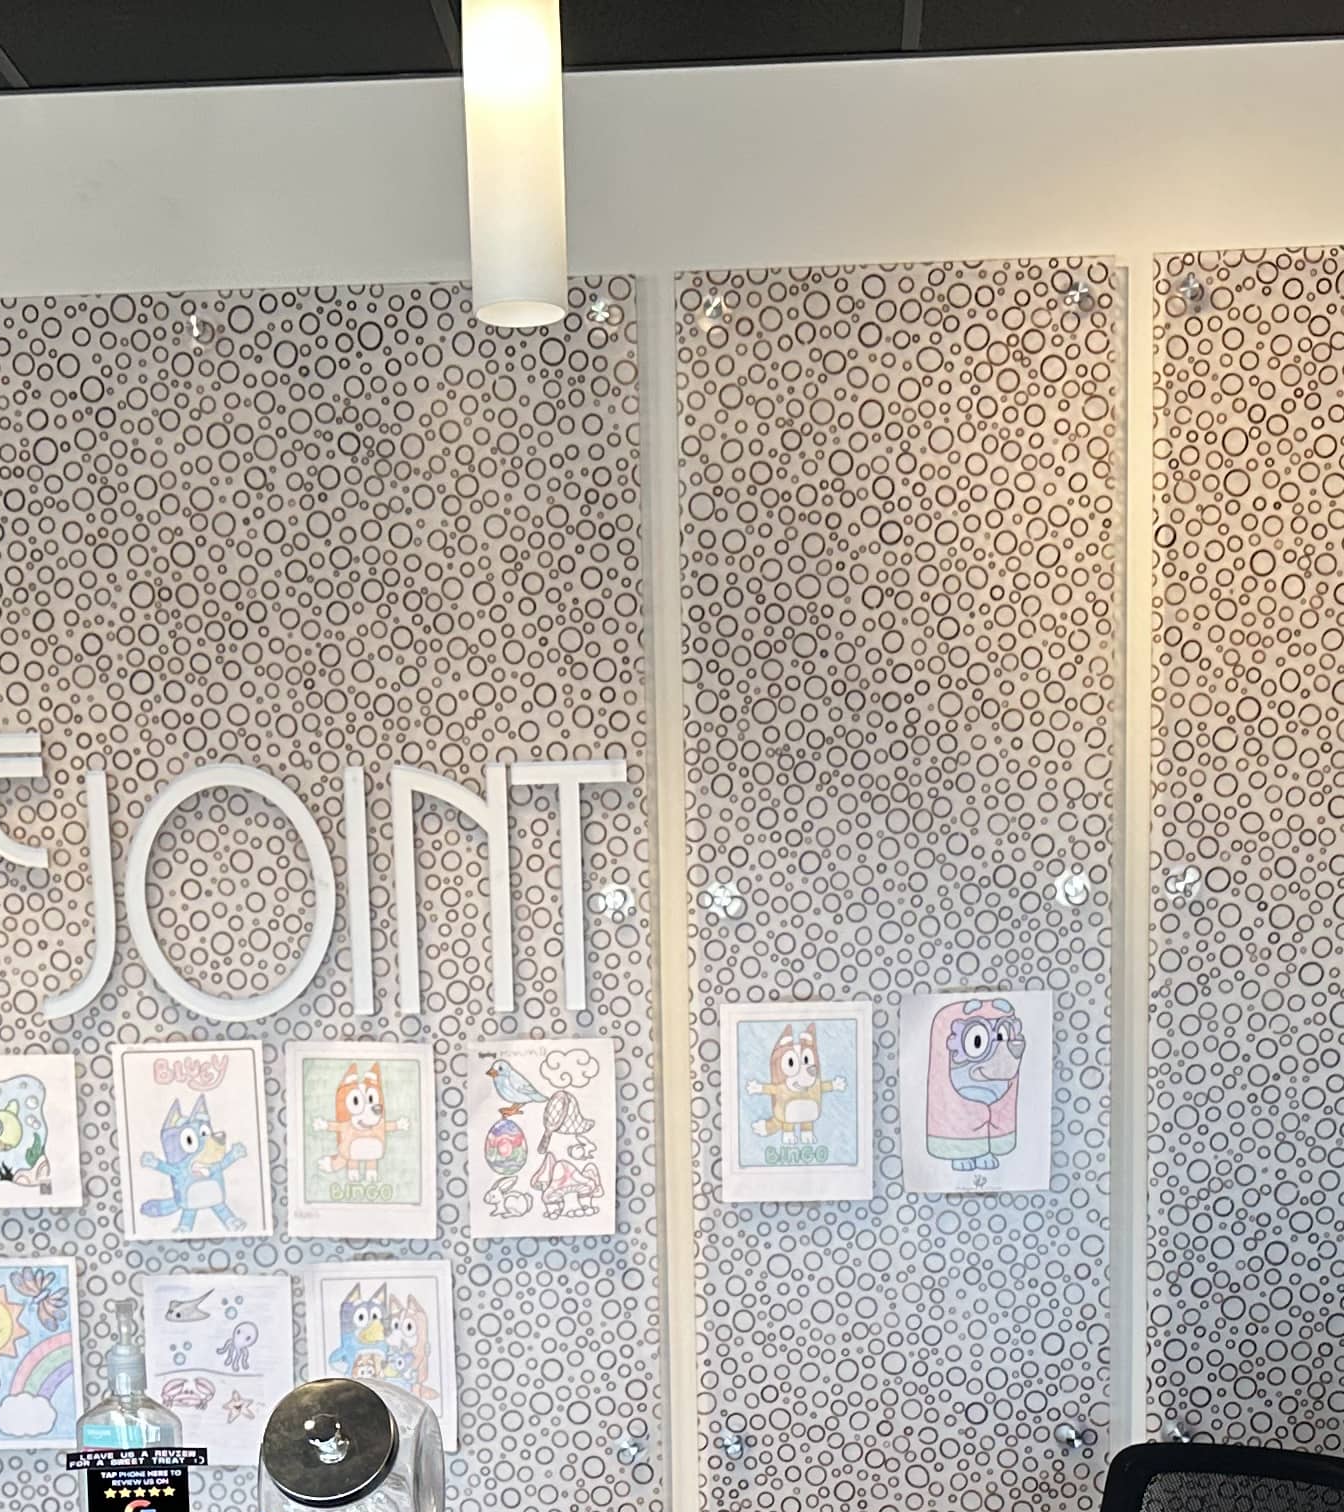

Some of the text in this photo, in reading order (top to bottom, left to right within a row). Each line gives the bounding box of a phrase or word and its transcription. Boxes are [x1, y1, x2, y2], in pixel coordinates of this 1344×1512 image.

[42, 758, 628, 1023] JOINT
[79, 1452, 114, 1461] LEAVE
[120, 1450, 135, 1459] US
[141, 1450, 149, 1458] A
[69, 1460, 90, 1468] FOR
[152, 1457, 185, 1465] TREAT
[101, 1471, 117, 1479] TAP
[118, 1470, 146, 1478] PHONE
[111, 1479, 142, 1487] REVIEW
[143, 1478, 154, 1486] US
